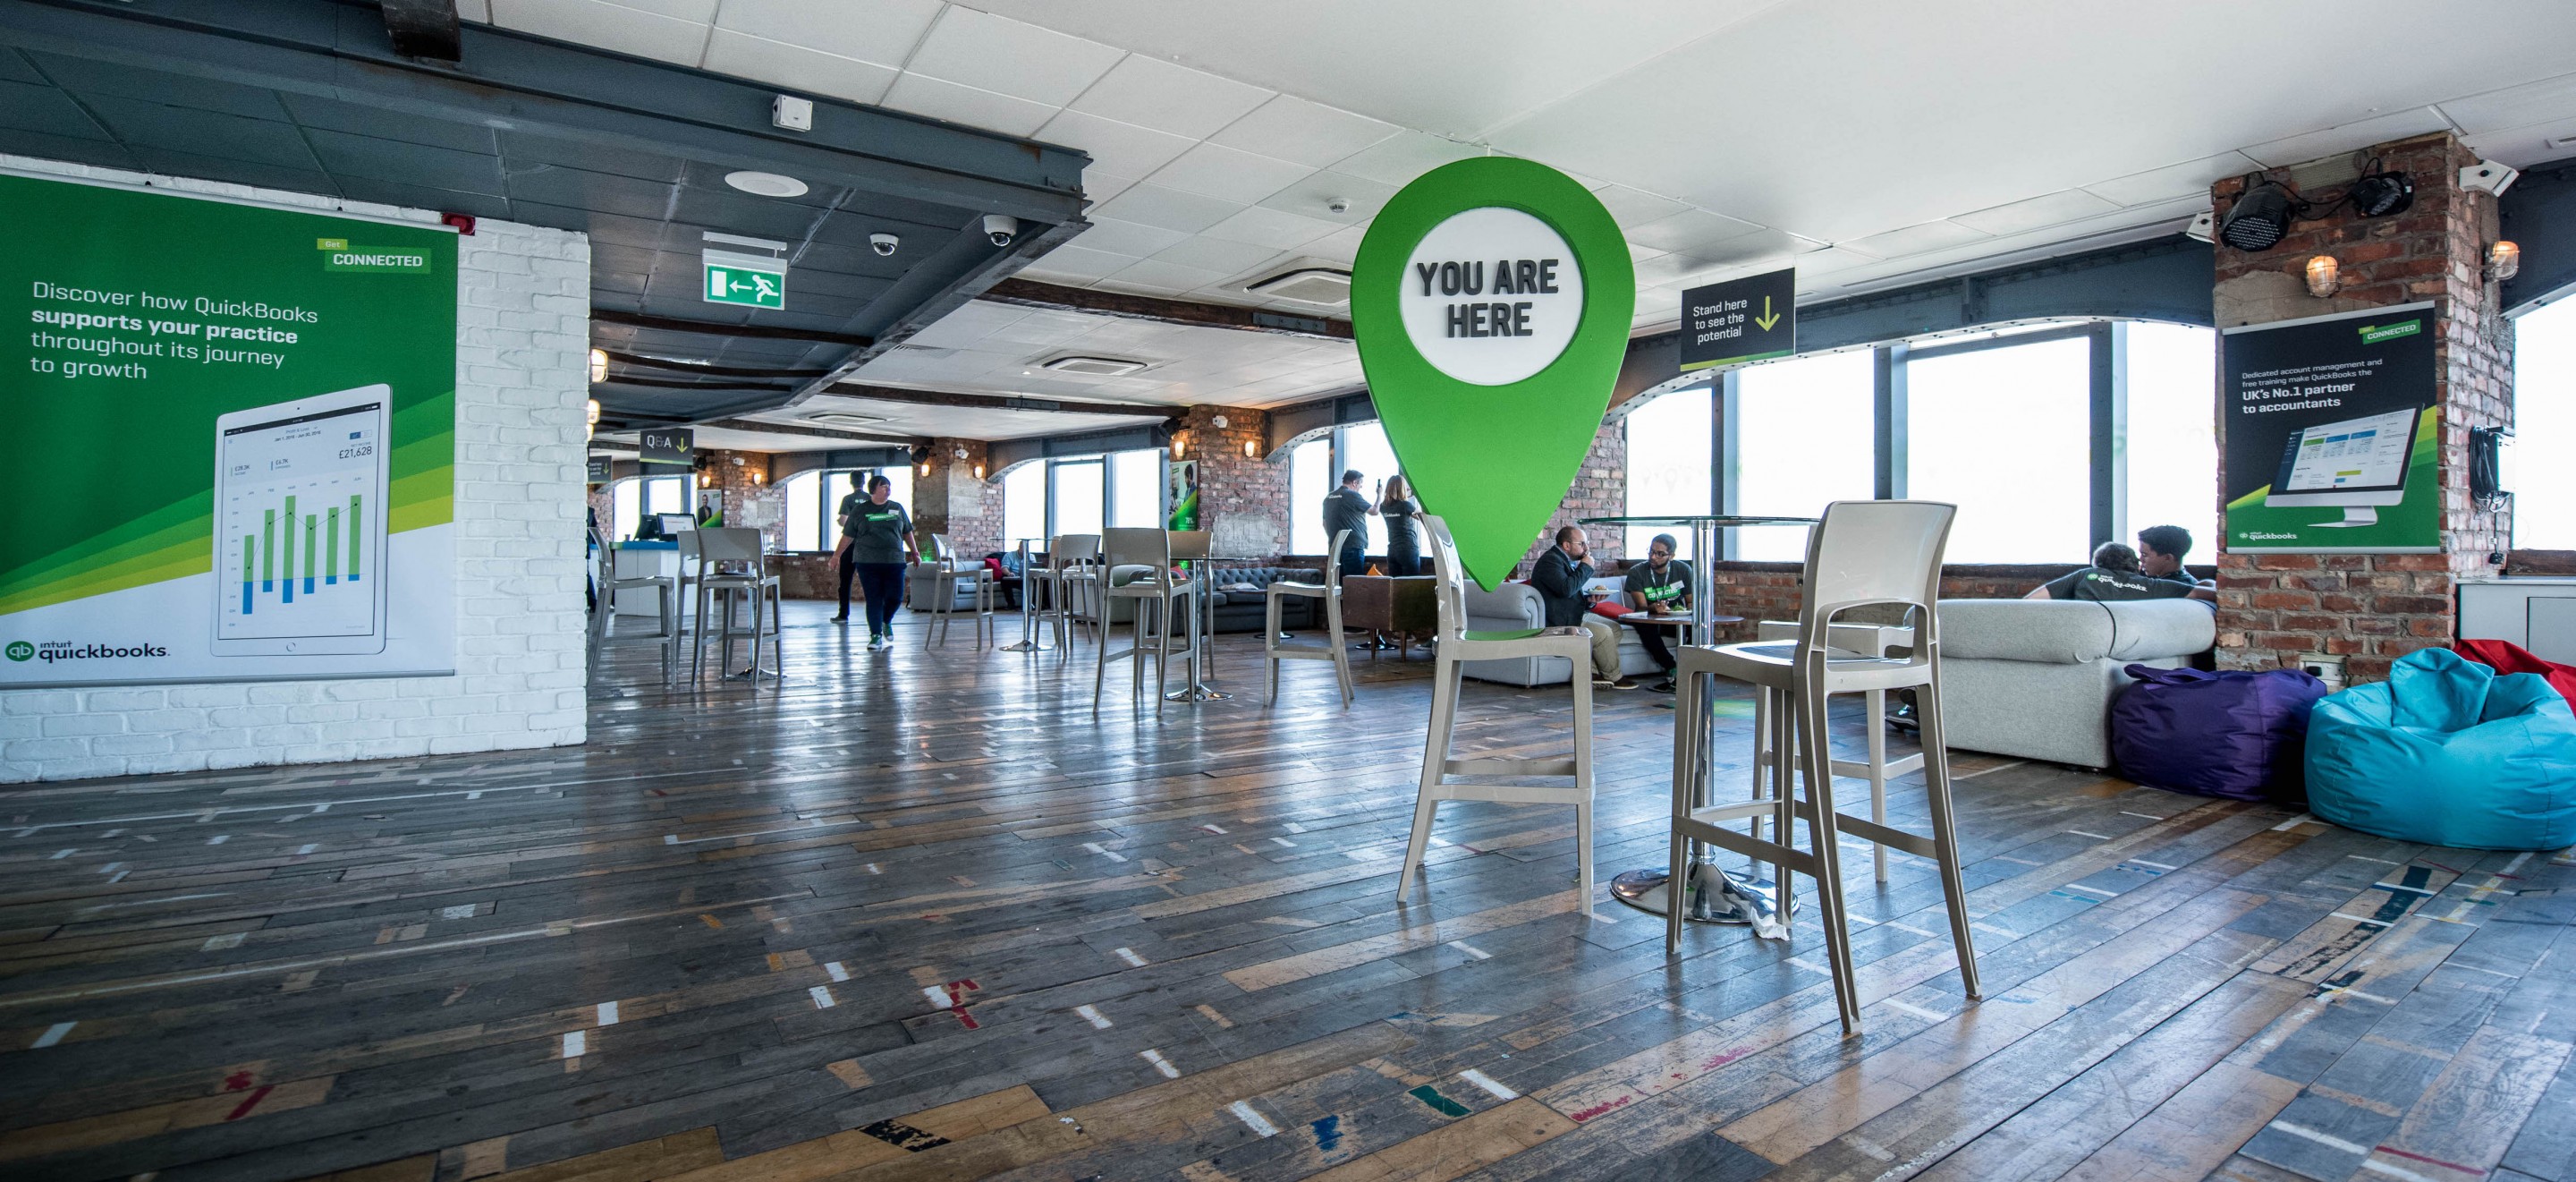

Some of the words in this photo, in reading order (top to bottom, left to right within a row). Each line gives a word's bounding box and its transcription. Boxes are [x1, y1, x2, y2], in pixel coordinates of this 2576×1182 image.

[333, 253, 423, 267] CONNECTED
[1417, 260, 1484, 297] YOU
[1493, 259, 1559, 295] ARE
[33, 281, 134, 306] Discover
[141, 291, 188, 311] how
[194, 296, 318, 323] QuickBooks
[1692, 302, 1723, 318] Stand
[1724, 299, 1748, 311] here
[31, 309, 143, 331] supports
[148, 319, 200, 336] your
[206, 324, 299, 344] practice
[1446, 302, 1533, 338] HERE
[1695, 320, 1706, 330] to
[1707, 318, 1725, 328] see
[1727, 312, 1745, 325] the
[1697, 326, 1741, 346] potential
[2367, 324, 2417, 341] CONNECTED
[30, 331, 164, 357] throughout
[170, 341, 199, 360] its
[202, 344, 285, 370] journey
[30, 357, 55, 373] to
[63, 359, 148, 379] growth
[2241, 369, 2279, 379] Dedicated
[2280, 366, 2311, 376] account
[2312, 361, 2366, 373] management
[2367, 358, 2383, 367] and
[2241, 379, 2258, 388] free
[2258, 377, 2287, 387] training
[2288, 374, 2310, 384] make
[2311, 370, 2357, 382] QuickBooks
[2359, 369, 2373, 377] the
[2273, 387, 2302, 398] No.1
[2305, 382, 2356, 397] partner
[2242, 404, 2257, 414] to
[2258, 397, 2342, 413] accountants
[647, 435, 672, 448] Q&A
[339, 446, 372, 460] £21,628
[2250, 532, 2297, 540] quickbooks
[40, 640, 72, 649] intuit
